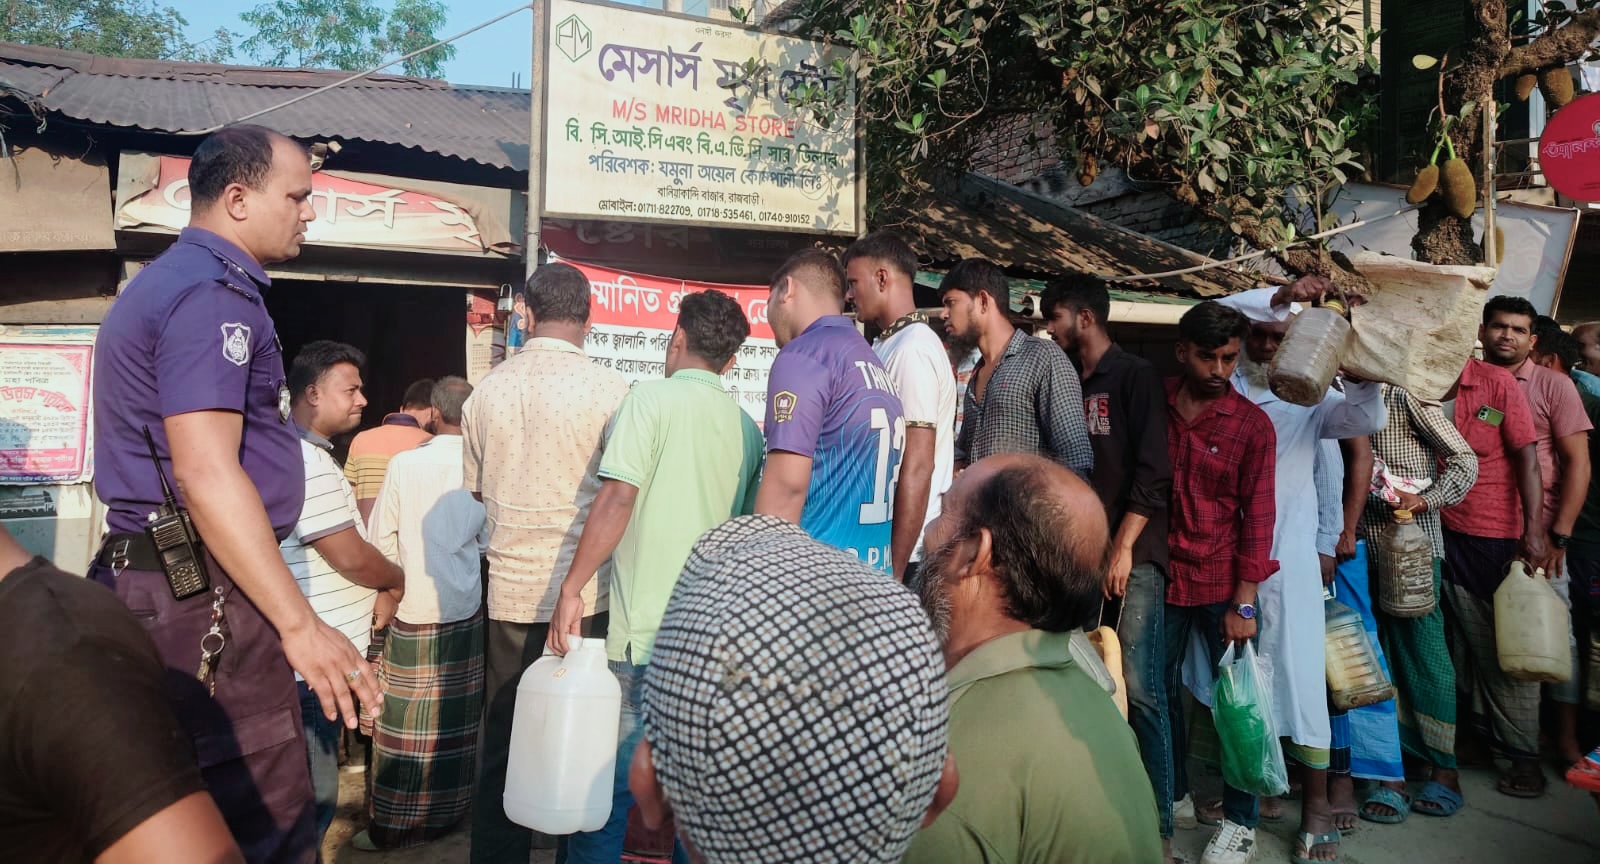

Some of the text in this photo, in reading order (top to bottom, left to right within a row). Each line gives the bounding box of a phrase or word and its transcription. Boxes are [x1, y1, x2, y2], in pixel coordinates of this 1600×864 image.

[598, 41, 704, 92] মেসার্স
[612, 97, 796, 139] M/S MRIDHA STORE
[766, 144, 791, 163] সার
[658, 160, 694, 186] যমুনা
[697, 164, 737, 183] অয়েল
[758, 211, 810, 225] 01740-910152
[590, 274, 662, 317] ম্মানিত
